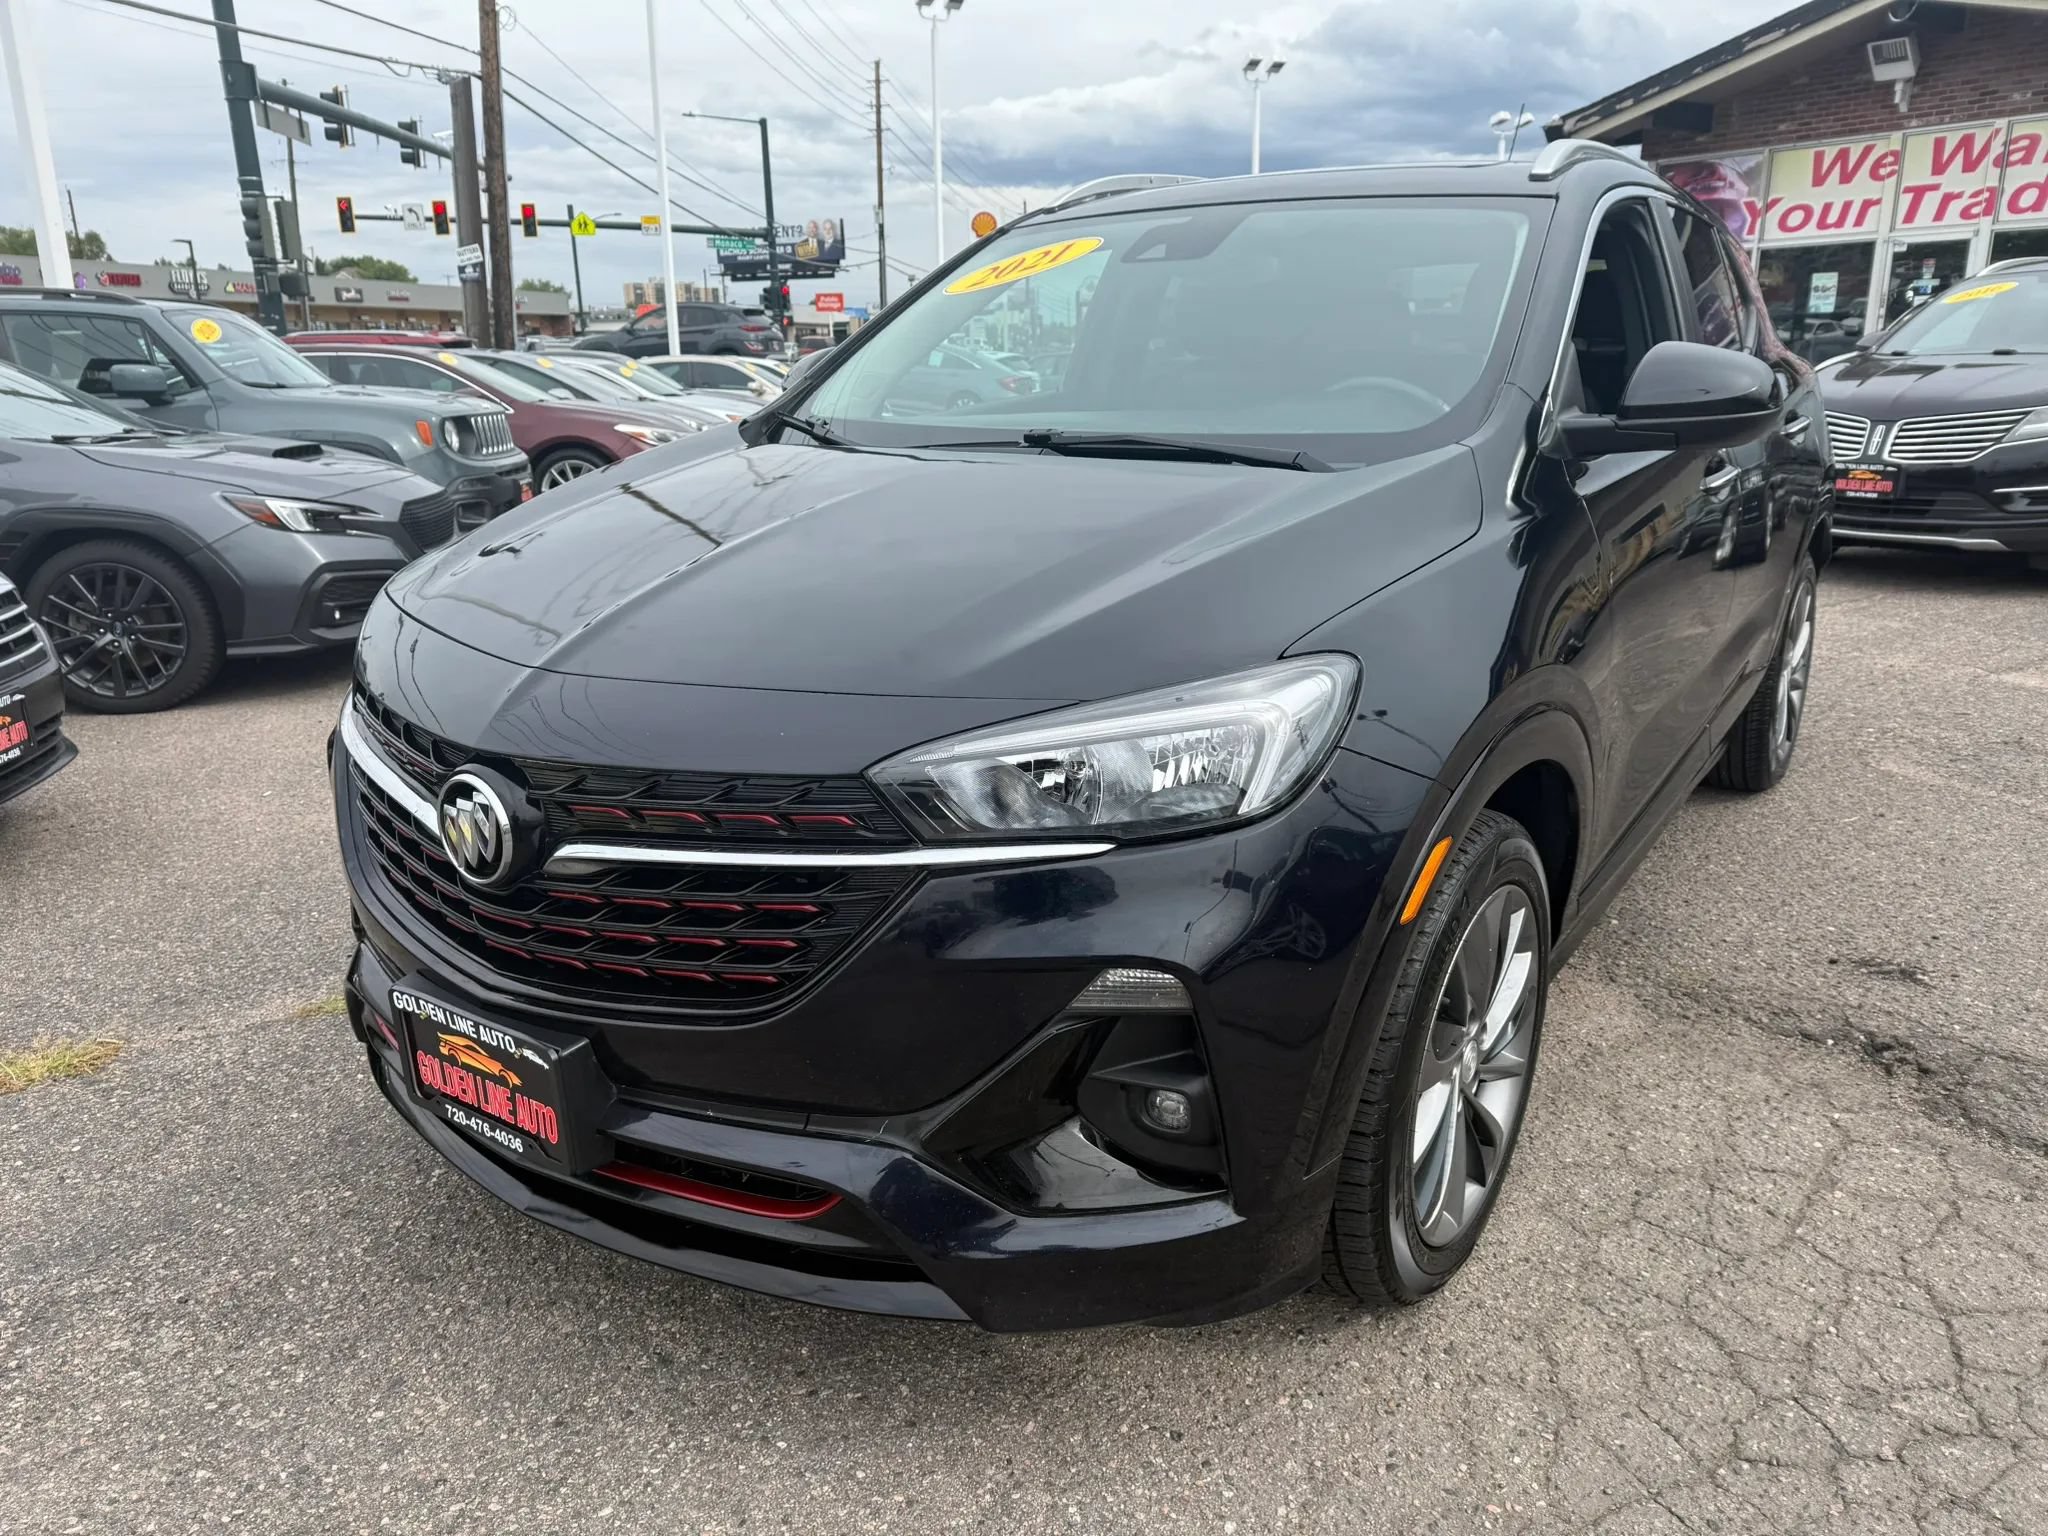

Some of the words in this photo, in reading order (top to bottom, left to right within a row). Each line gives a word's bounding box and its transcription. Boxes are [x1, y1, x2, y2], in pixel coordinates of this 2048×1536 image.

[1810, 143, 1901, 188] We
[1930, 127, 2048, 177] Wa
[1744, 196, 1882, 236] Your
[714, 239, 743, 248] Monaco
[965, 242, 1077, 289] 2021
[1861, 479, 1875, 491] LINE
[1875, 480, 1893, 492] AUTO
[1869, 463, 1884, 471] AUTO
[9, 720, 29, 746] AUTO
[393, 991, 447, 1023] GOLDEN
[449, 1011, 477, 1037] LINE
[479, 1023, 517, 1054] AUTO
[416, 1050, 477, 1108] GOLDEN
[476, 1075, 515, 1123] LINE
[515, 1093, 559, 1145] AUTO
[445, 1104, 524, 1153] 720-476-4036
